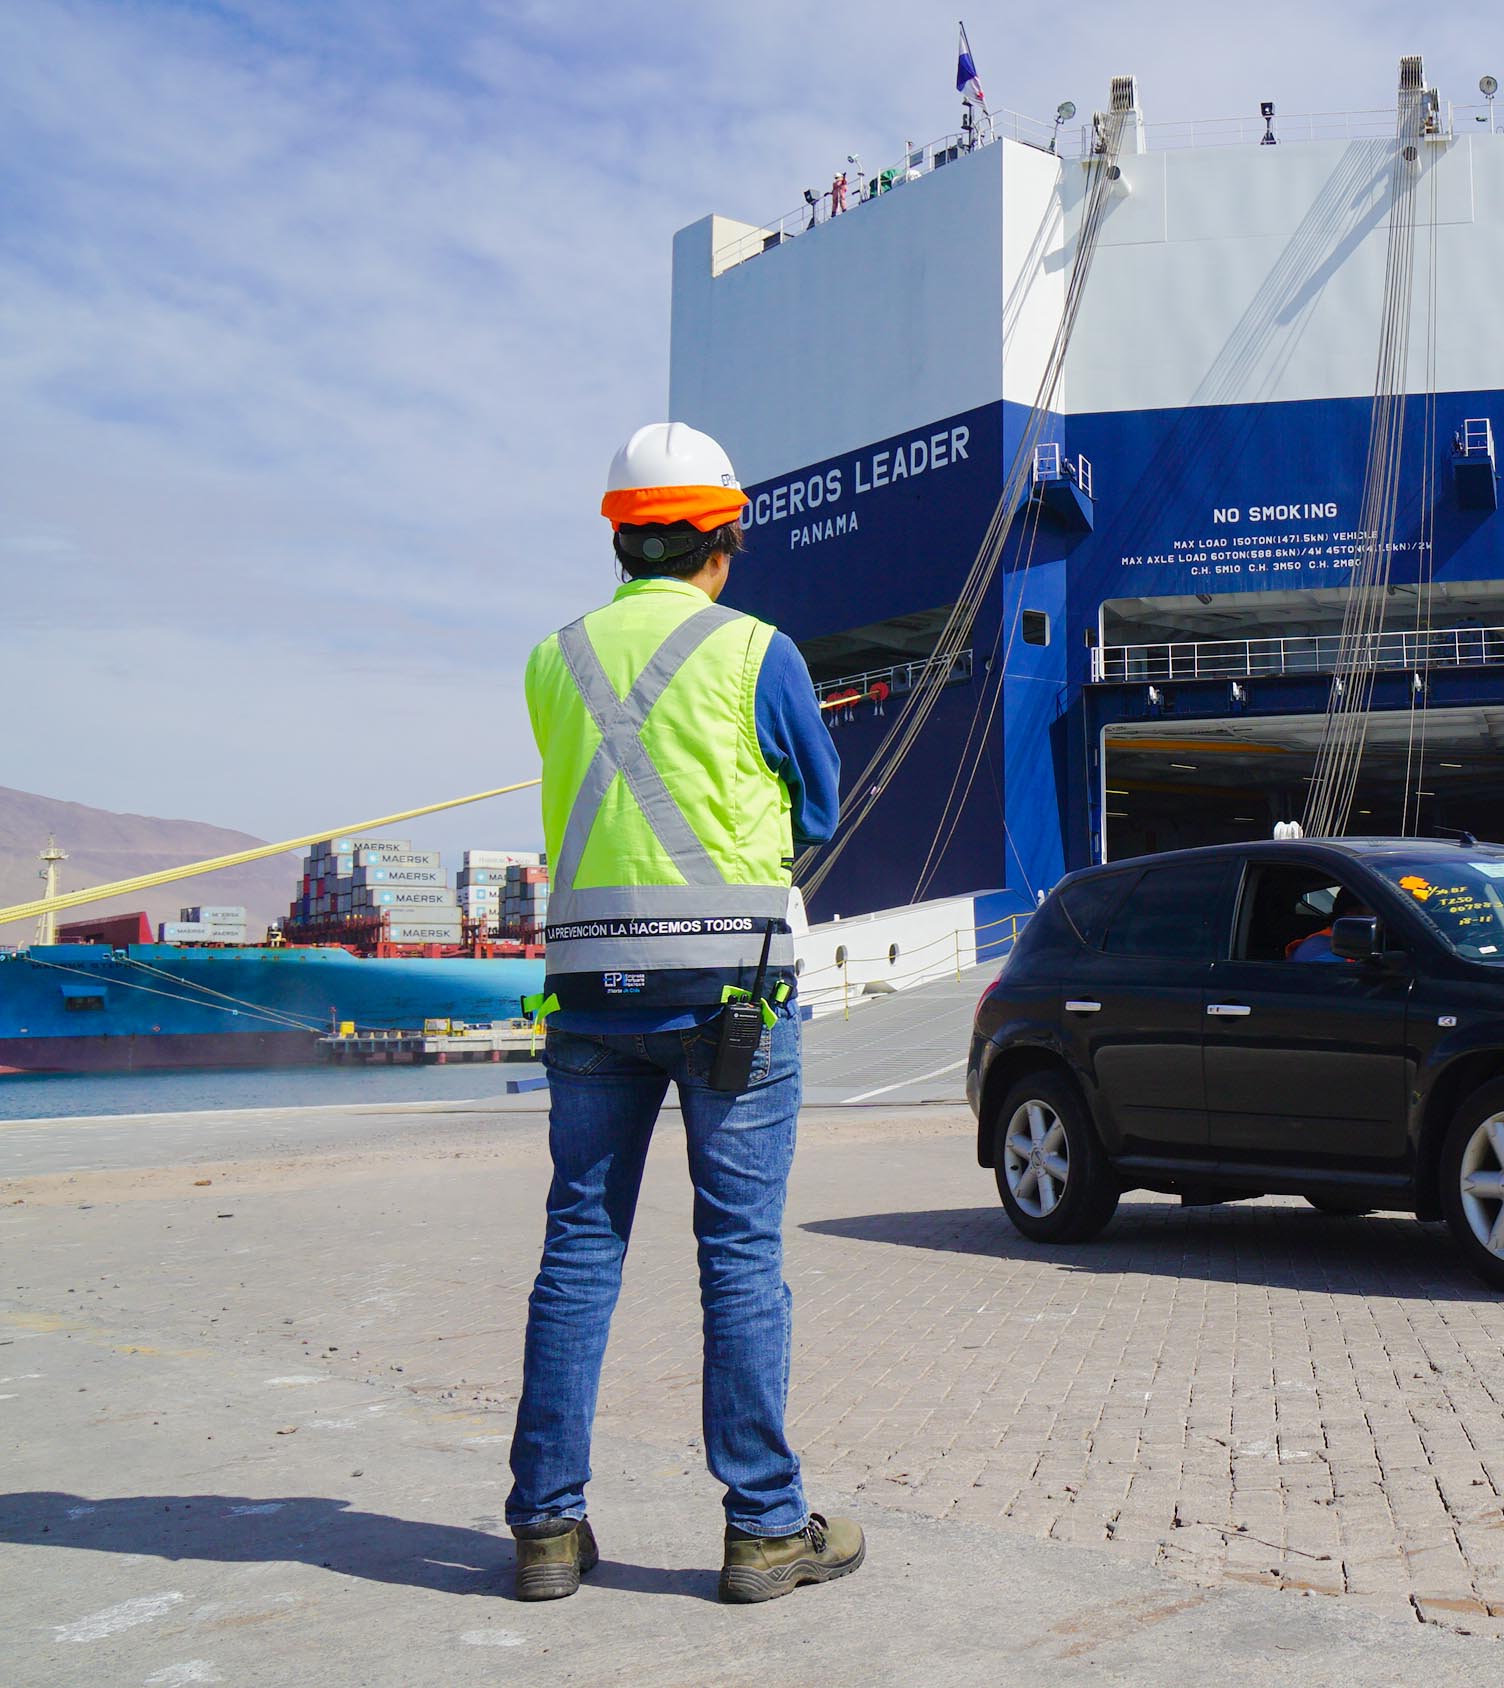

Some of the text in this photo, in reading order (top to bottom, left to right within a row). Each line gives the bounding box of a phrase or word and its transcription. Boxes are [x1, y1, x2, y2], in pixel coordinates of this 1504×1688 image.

[855, 425, 970, 494] LEADER
[1213, 502, 1338, 523] NO SMOKING
[790, 511, 859, 550] PANAMA
[1173, 540, 1195, 549] MAX
[1198, 538, 1228, 548] LOAD
[1332, 530, 1378, 541] VEHICLE
[1121, 556, 1143, 566] MAX
[1146, 554, 1175, 564] AXLE
[1178, 552, 1207, 562] LOAD
[1190, 558, 1362, 576] C.H. 5M10 C.H. 3M50 C.H. 2M80
[353, 842, 401, 851] MAERSK
[382, 855, 429, 864] MAERSK
[388, 872, 436, 881] MAERSK
[395, 894, 443, 903] MAERSK
[402, 929, 451, 938] MAERSK
[555, 923, 607, 939] PREVENCIÓN
[610, 923, 627, 936] LA
[629, 920, 702, 935] HACEMOS
[704, 918, 753, 932] TODOS
